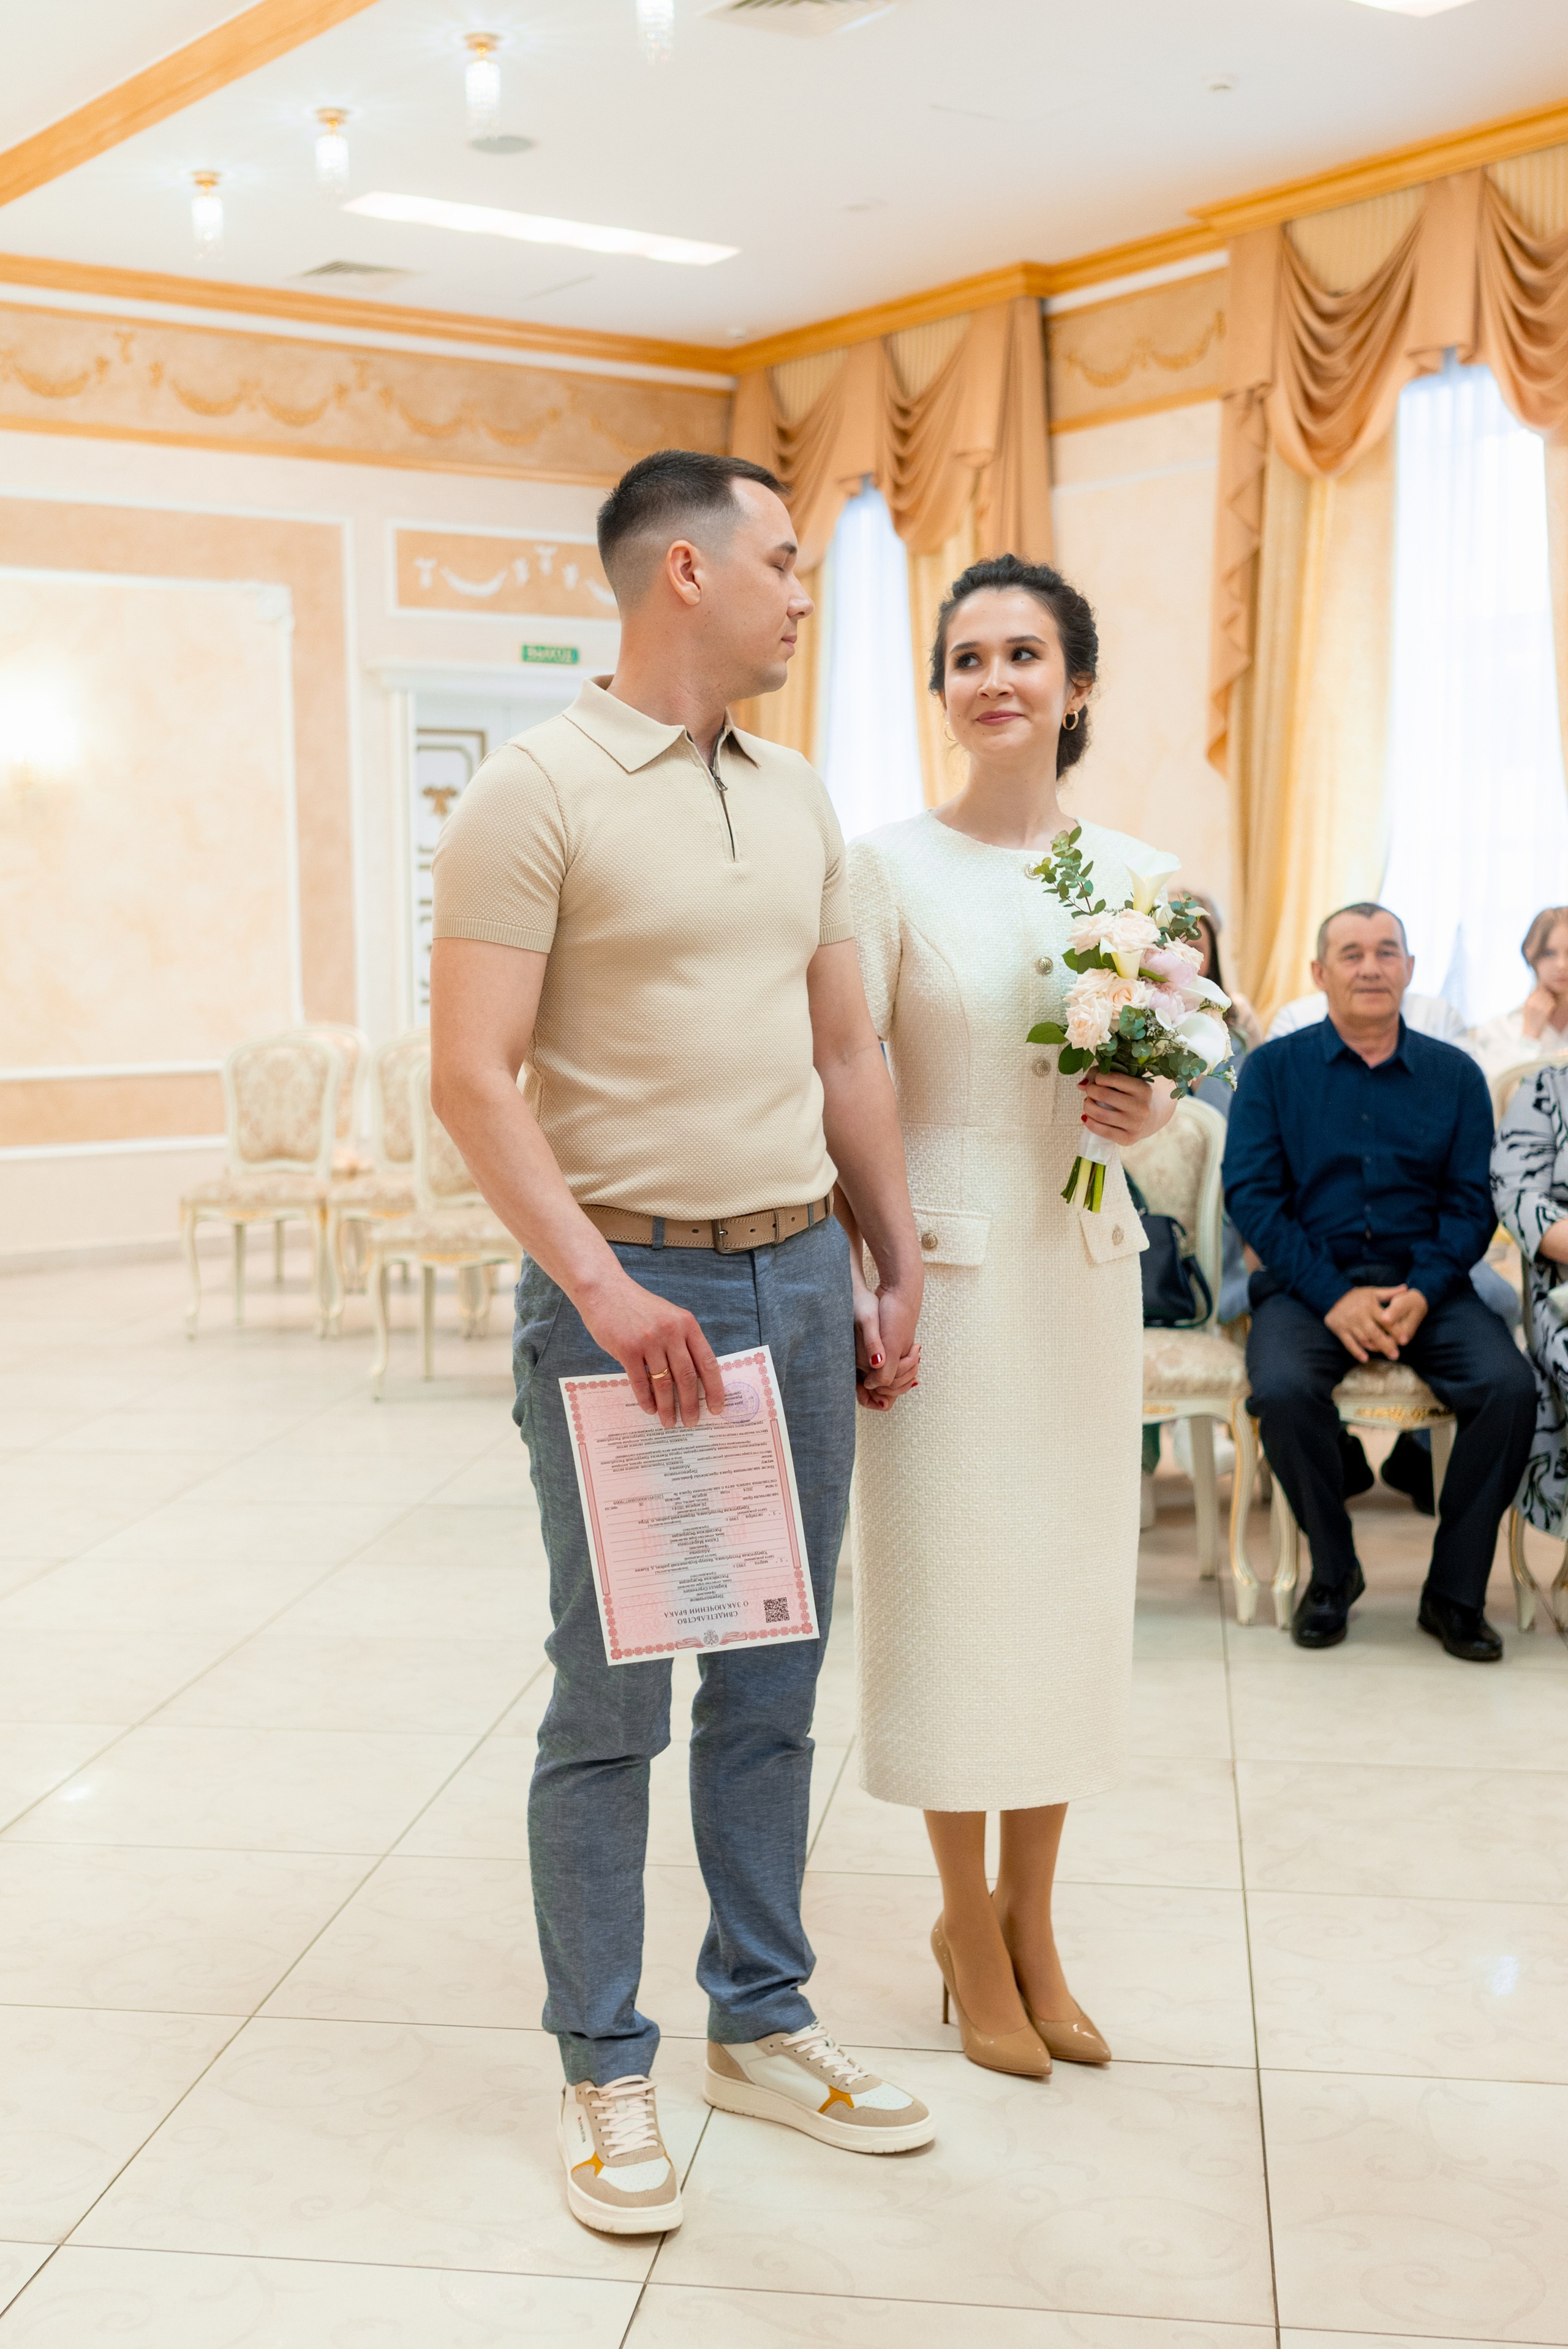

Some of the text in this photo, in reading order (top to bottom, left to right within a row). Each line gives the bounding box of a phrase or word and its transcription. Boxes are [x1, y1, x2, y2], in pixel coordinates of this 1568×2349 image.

[663, 1468, 698, 1477] Перевозчиков
[733, 1465, 761, 1474] заключения
[677, 1539, 704, 1547] Маратовна
[690, 1593, 723, 1602] Перевозчиков
[689, 1601, 741, 1614] ЗАКЛЮЧЕНИИ
[663, 1609, 687, 1618] БРАКА
[676, 1610, 738, 1624] СВИДЕТЕЛЬСТВО
